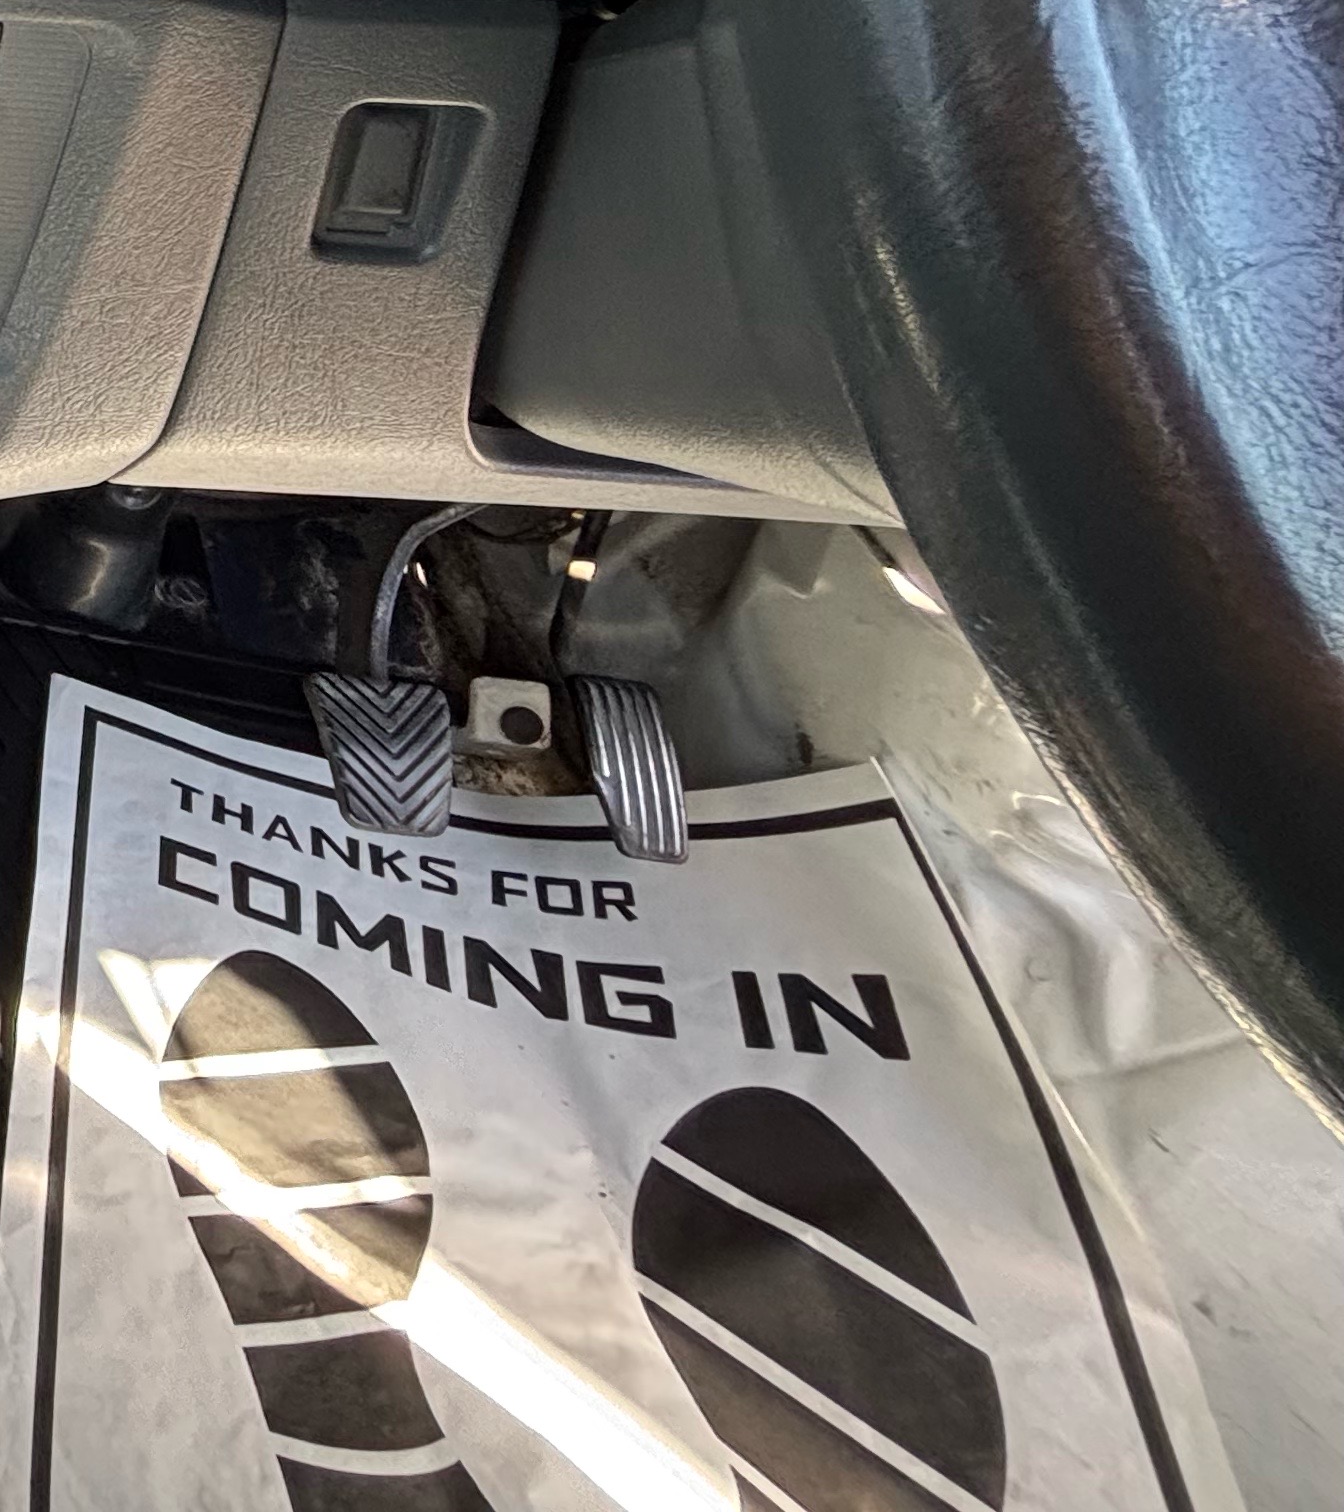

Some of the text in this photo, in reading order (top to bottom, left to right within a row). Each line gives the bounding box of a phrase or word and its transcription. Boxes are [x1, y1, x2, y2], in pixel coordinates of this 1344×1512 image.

[169, 777, 640, 921] THANKS FOR
[157, 835, 913, 1062] COMING IN
